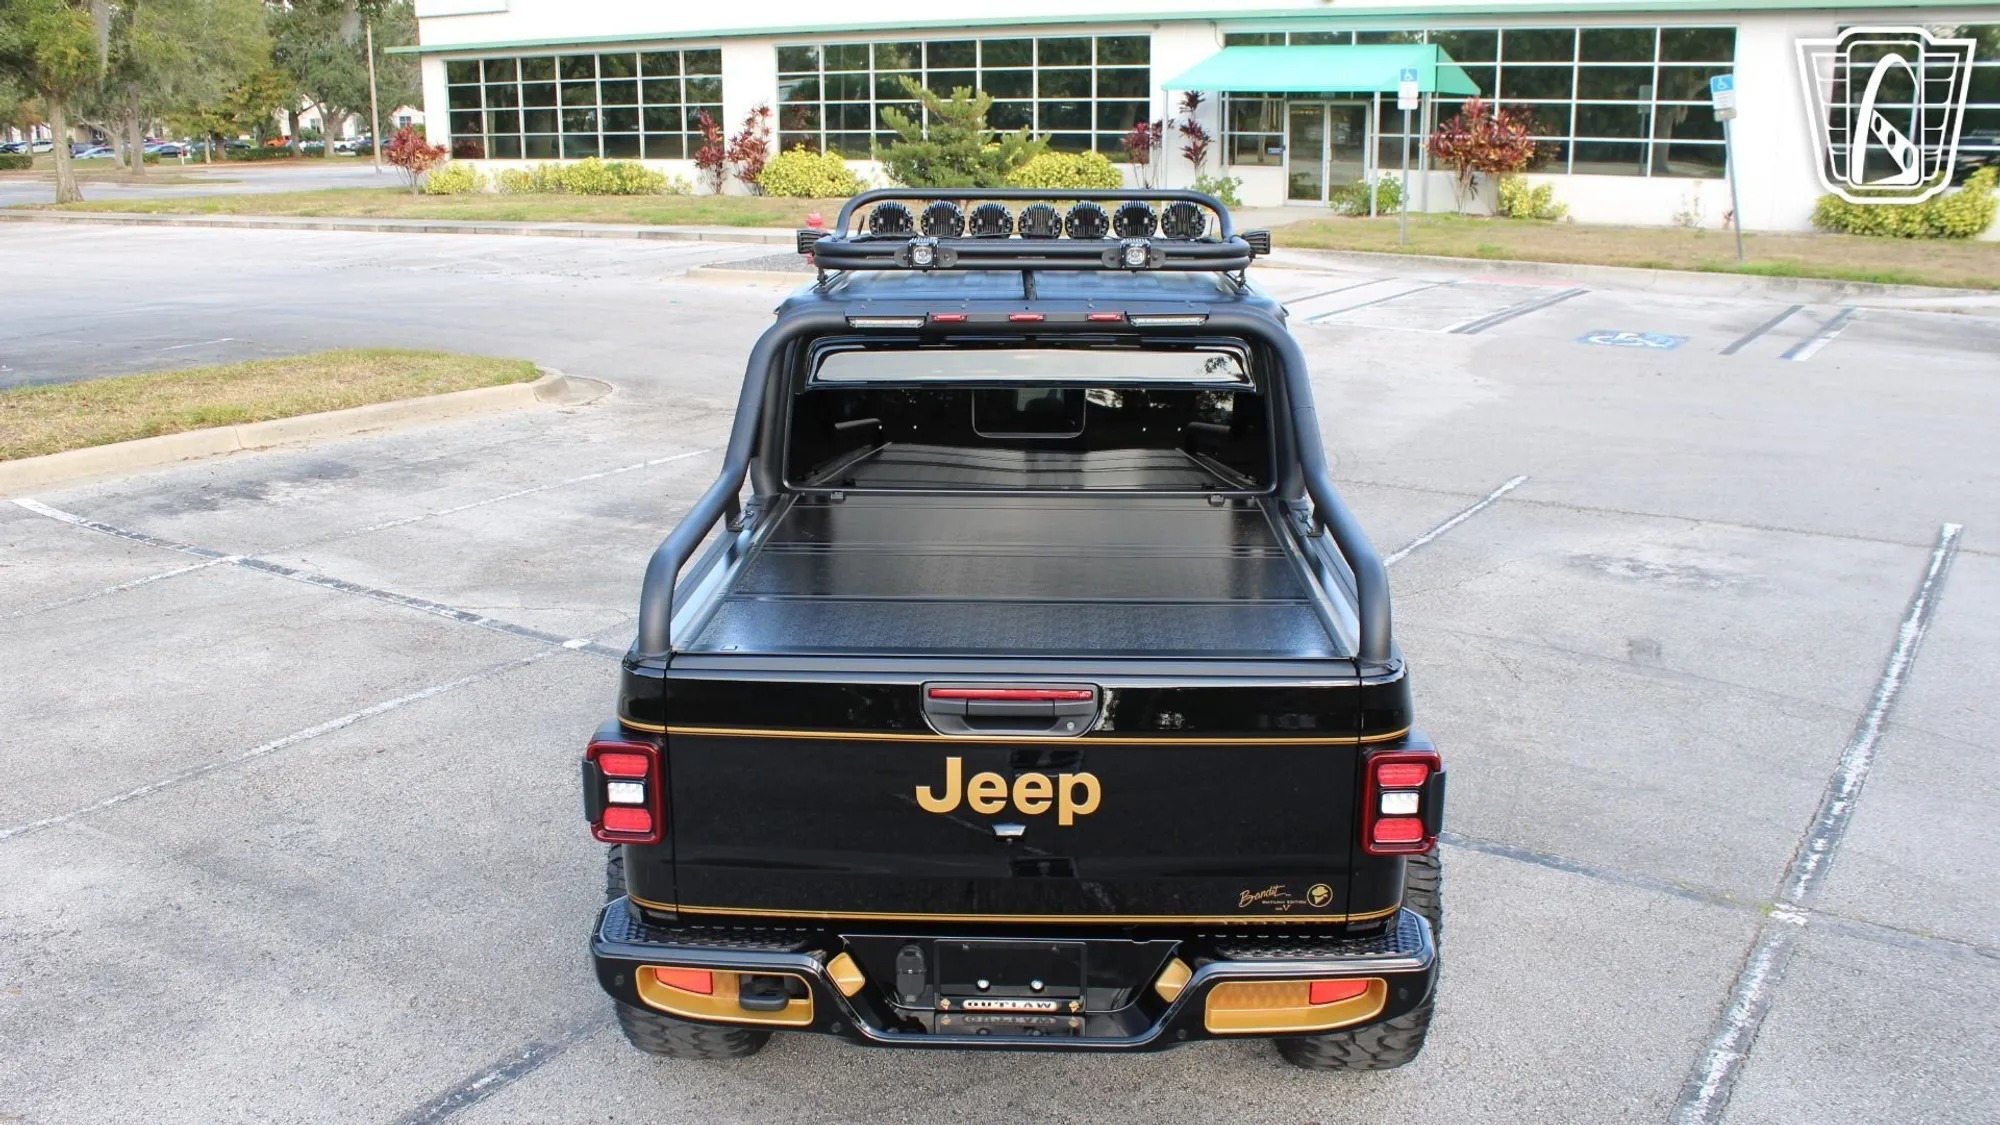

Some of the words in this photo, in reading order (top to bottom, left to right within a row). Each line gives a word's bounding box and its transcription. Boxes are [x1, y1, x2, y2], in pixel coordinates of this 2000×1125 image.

[916, 756, 1101, 825] Jeep
[1239, 885, 1286, 908] Bandit
[965, 1000, 1053, 1010] OUTLAW
